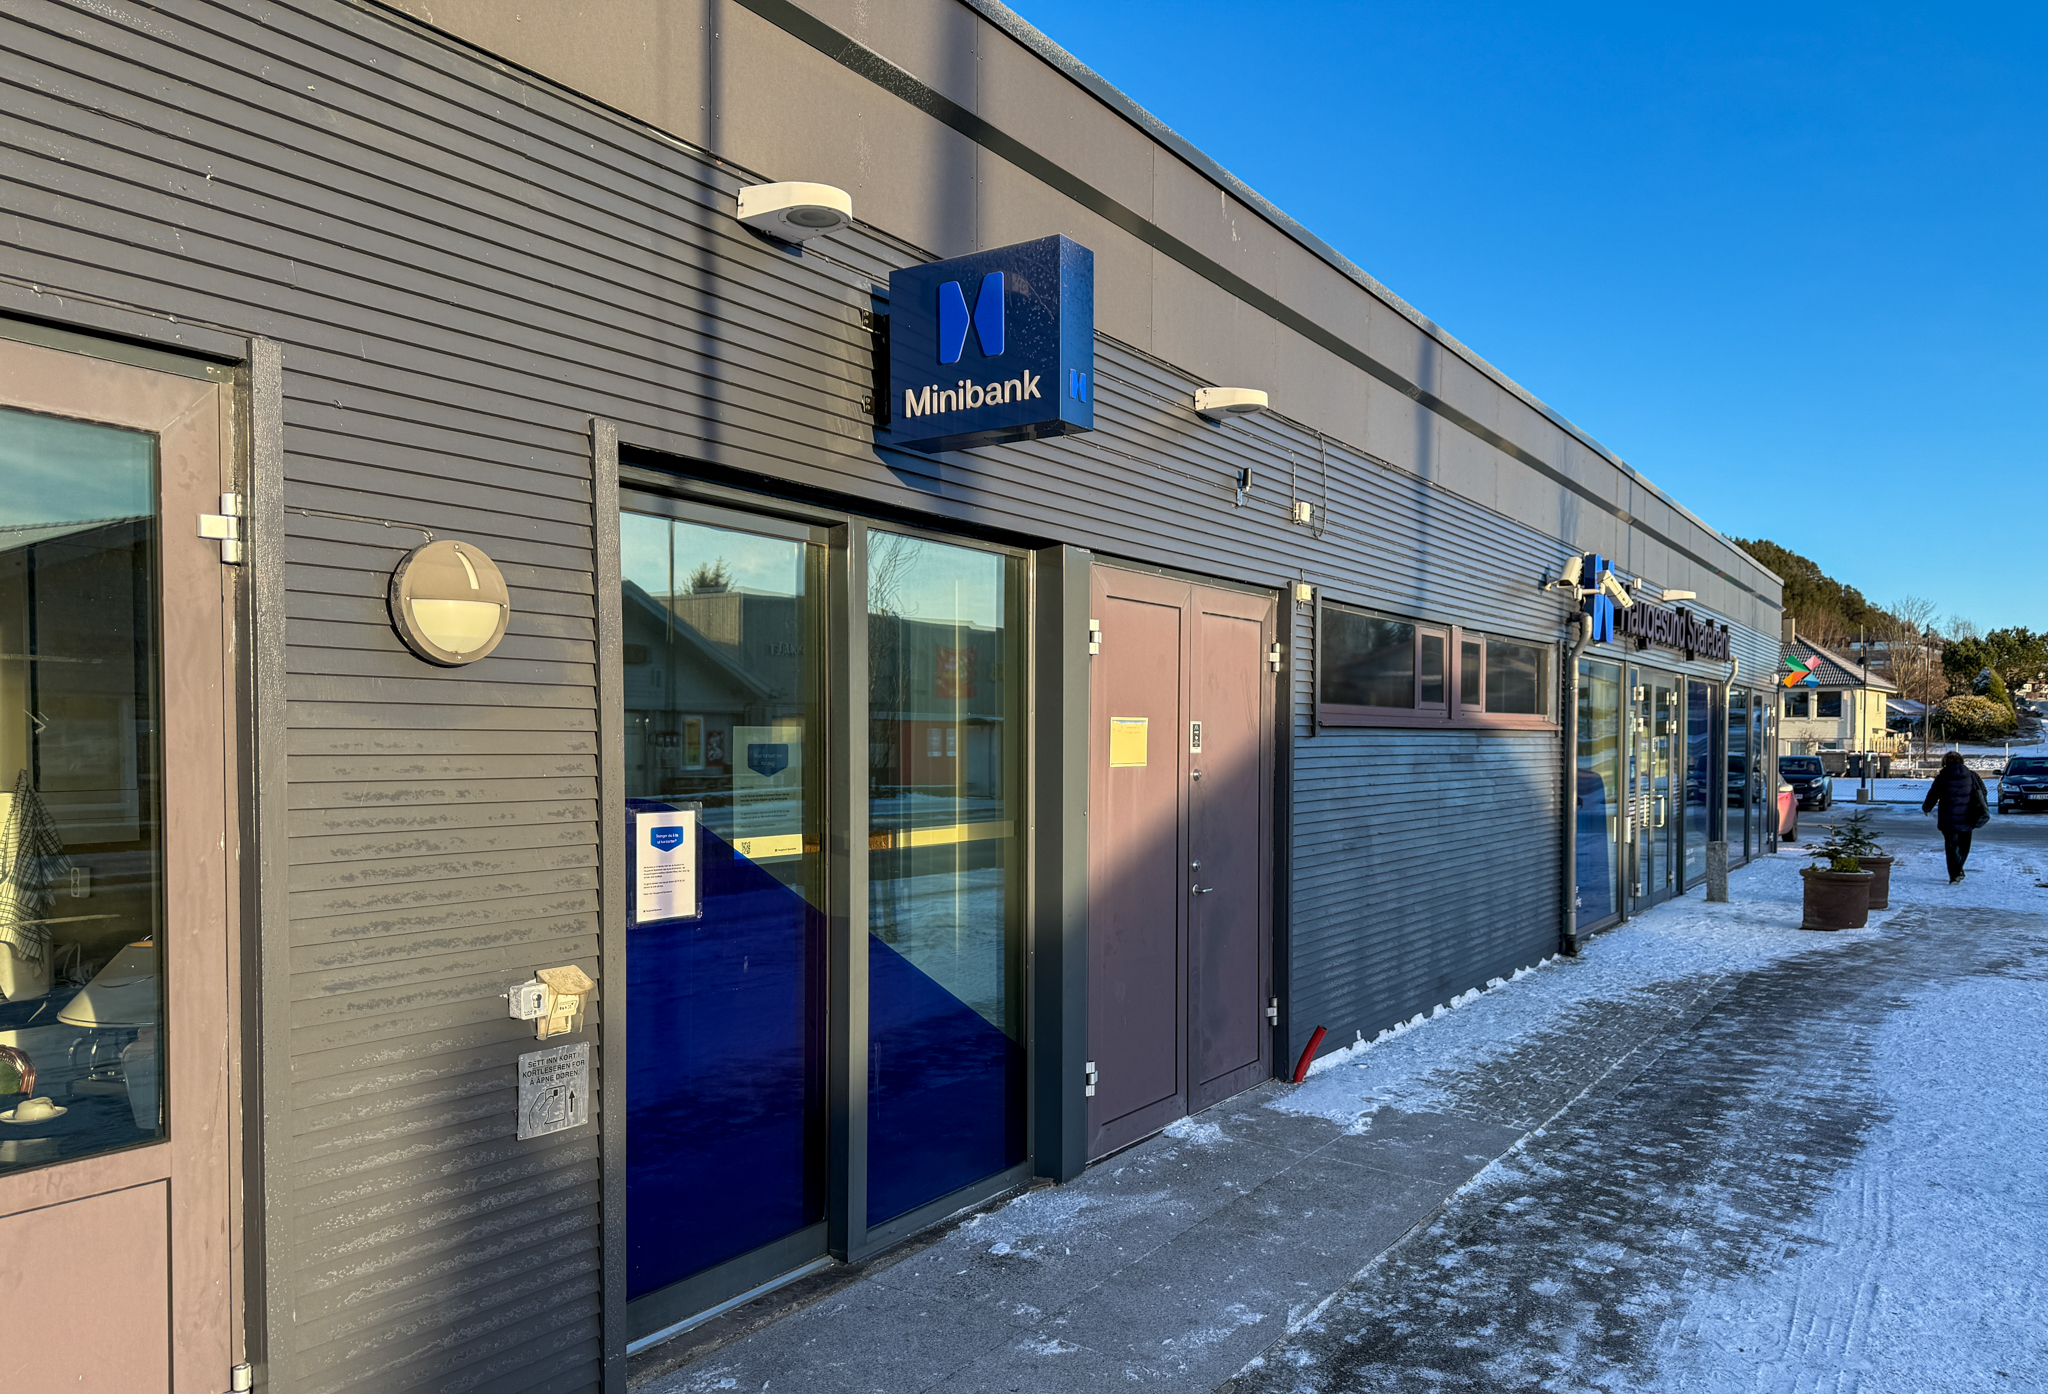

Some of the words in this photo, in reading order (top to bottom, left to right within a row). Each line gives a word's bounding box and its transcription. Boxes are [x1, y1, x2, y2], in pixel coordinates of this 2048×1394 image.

[905, 369, 1042, 418] Minibank
[1618, 584, 1687, 651] Haugesund
[1685, 609, 1731, 662] Sparebank
[522, 1063, 571, 1079] KORTLESEREN
[572, 1059, 586, 1068] FOR
[528, 1059, 545, 1068] SETT
[546, 1056, 558, 1065] INN
[559, 1052, 577, 1062] KORT
[529, 1077, 535, 1086] Å
[536, 1074, 555, 1085] ÅPNE
[555, 1069, 579, 1081] DØREN
